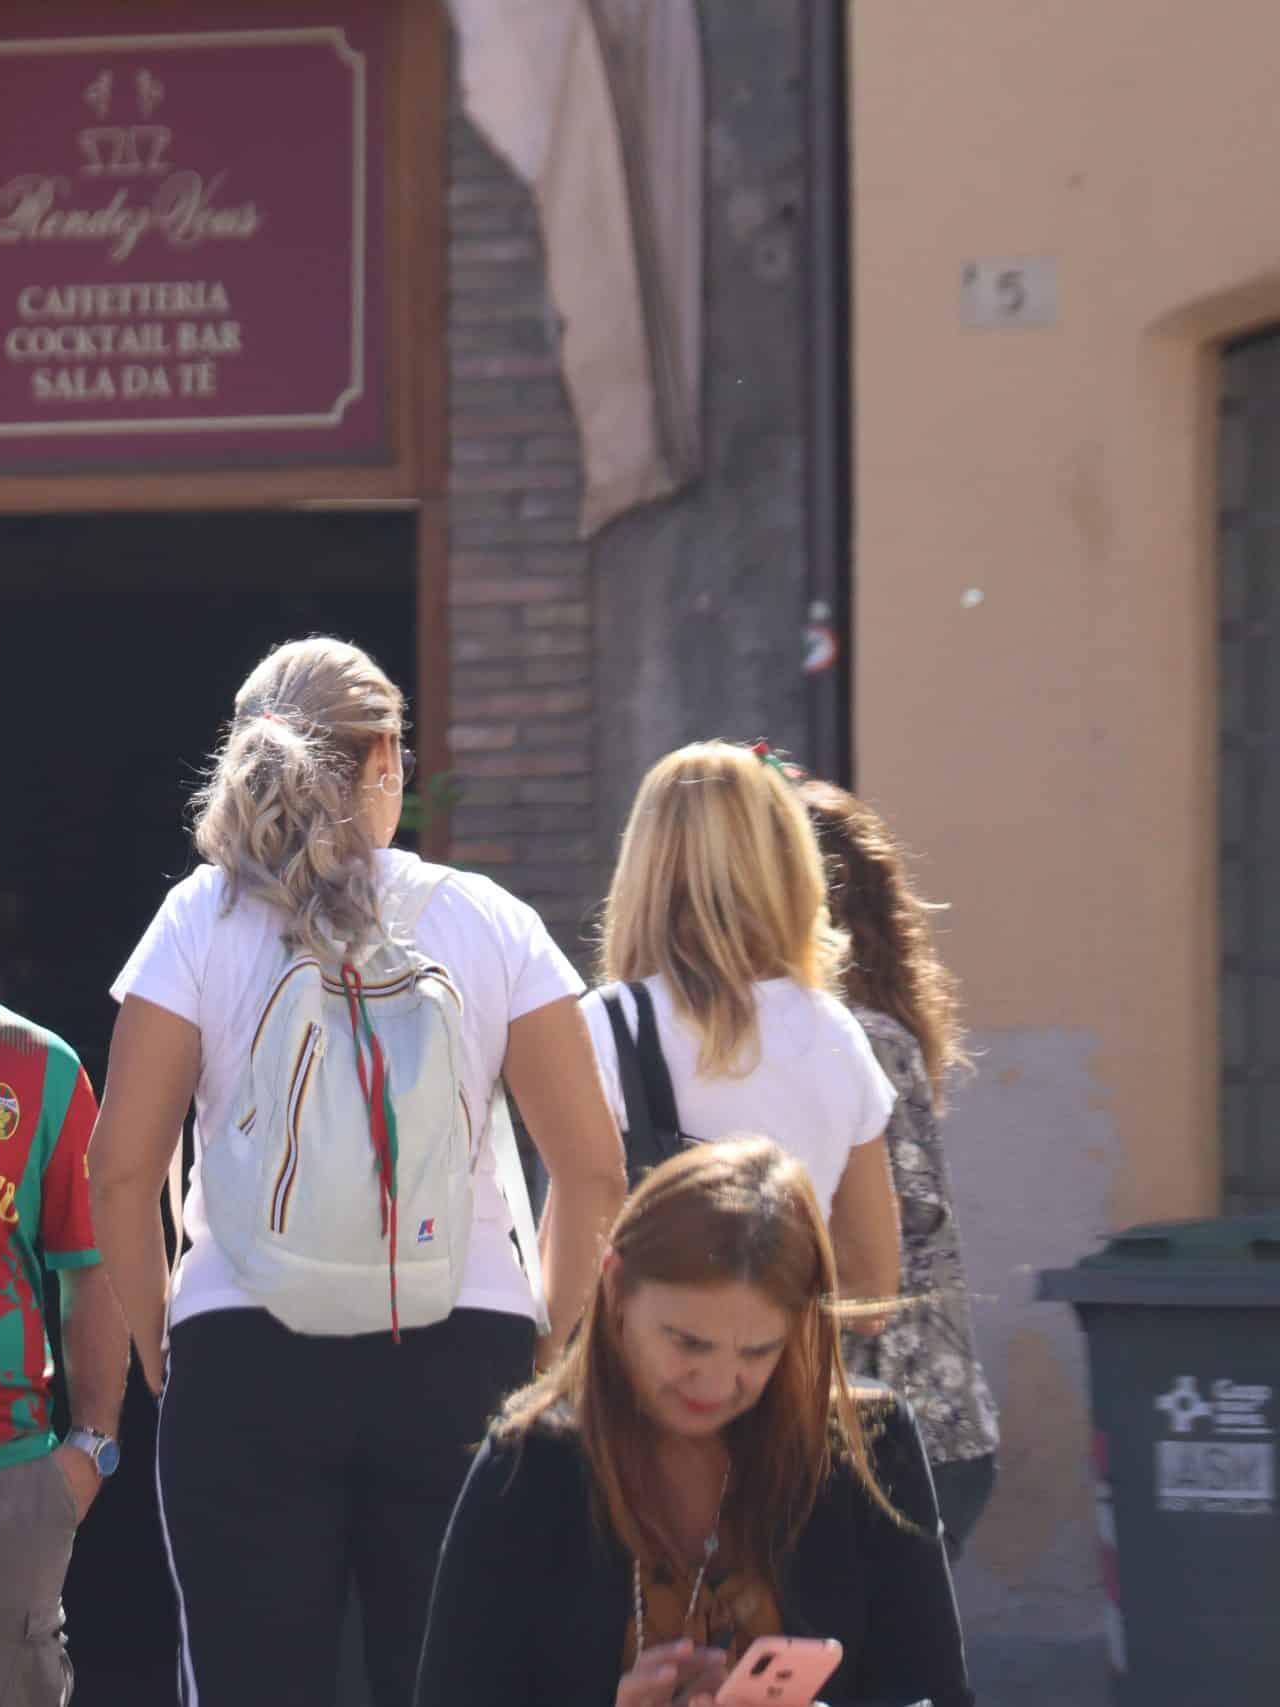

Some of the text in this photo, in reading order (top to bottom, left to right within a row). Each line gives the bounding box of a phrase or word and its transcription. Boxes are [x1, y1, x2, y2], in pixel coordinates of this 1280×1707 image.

[17, 280, 229, 318] CAFFETTERIA
[996, 269, 1026, 320] 5
[5, 319, 243, 361] COCKTAIL BAR
[32, 365, 115, 401] SALA
[122, 363, 172, 398] DA
